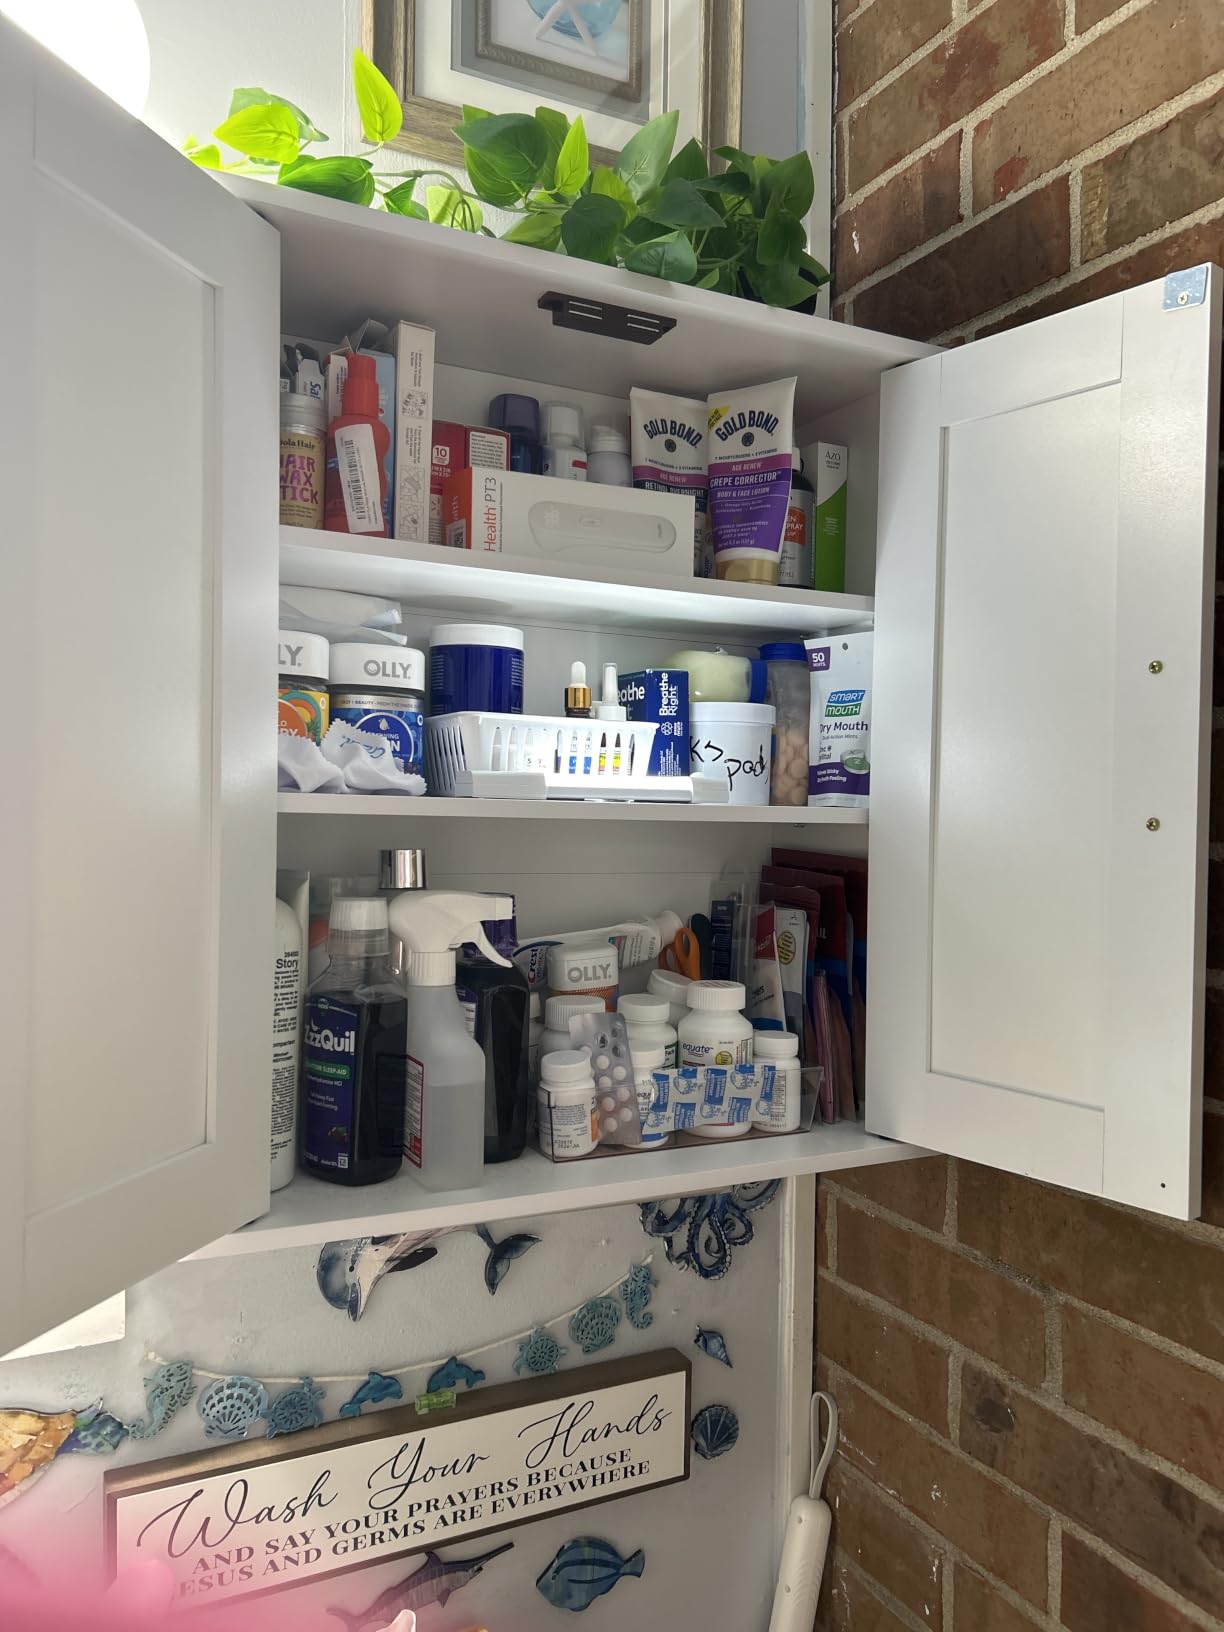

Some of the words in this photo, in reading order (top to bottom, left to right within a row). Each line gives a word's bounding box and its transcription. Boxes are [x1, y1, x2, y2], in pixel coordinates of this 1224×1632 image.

[643, 418, 668, 440] GOLD
[670, 420, 703, 448] BOND
[714, 412, 746, 442] GOLD
[748, 410, 779, 434] BOND
[434, 447, 448, 458] 10
[824, 450, 841, 461] AZO
[484, 477, 497, 502] PT3
[710, 477, 734, 488] CREPE
[734, 472, 777, 486] CORRECTOR
[280, 486, 319, 504] TICK
[483, 507, 497, 552] Health
[812, 652, 824, 663] 50
[658, 672, 669, 716] Breathe
[668, 685, 679, 716] Right
[834, 720, 868, 732] Mouth
[276, 958, 298, 970] Story
[528, 949, 538, 984] Crest
[682, 1042, 711, 1054] equate
[136, 1469, 338, 1559] Wash
[367, 1436, 490, 1510] Your
[517, 1394, 672, 1469] Hands
[192, 1546, 254, 1574] AND
[264, 1528, 316, 1556] SAY
[324, 1508, 400, 1540] YOUR
[408, 1477, 518, 1519] PRAYERS
[527, 1448, 632, 1488] BECAUSE
[178, 1565, 254, 1598] ESUS
[262, 1548, 322, 1576] AND
[332, 1520, 426, 1556] GERMS
[433, 1504, 483, 1530] ARE
[490, 1460, 650, 1515] EVERYWHERE
